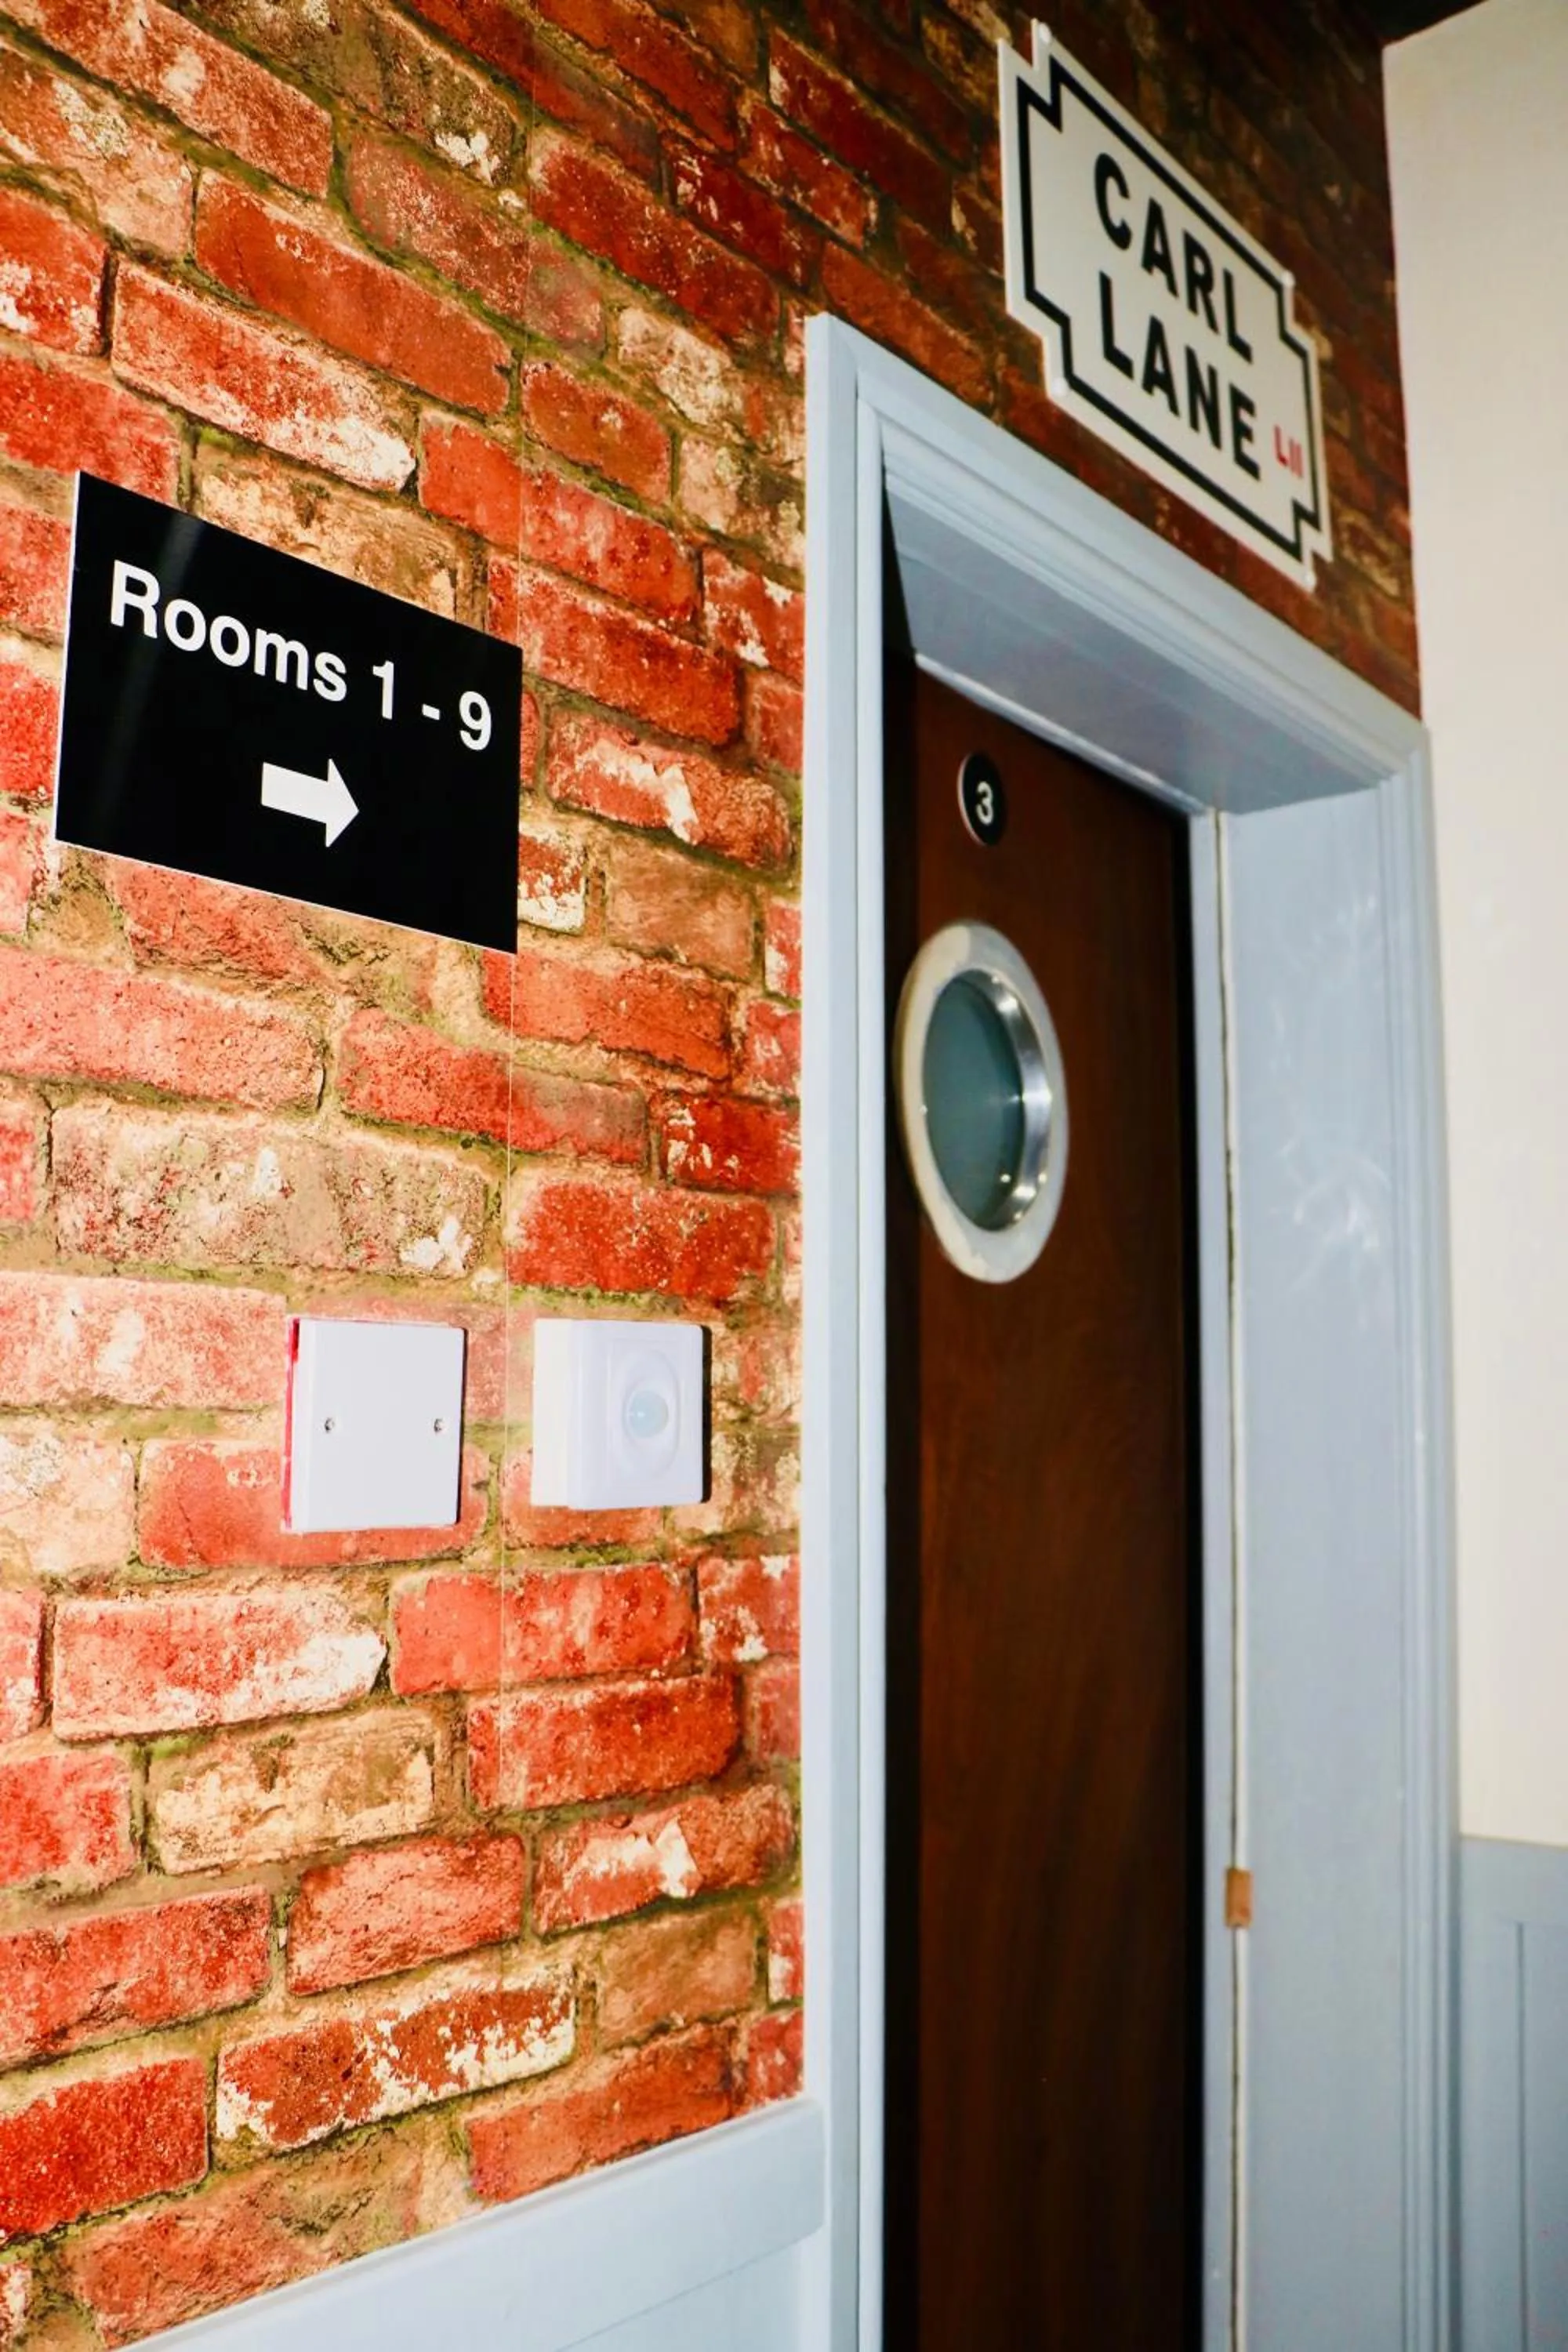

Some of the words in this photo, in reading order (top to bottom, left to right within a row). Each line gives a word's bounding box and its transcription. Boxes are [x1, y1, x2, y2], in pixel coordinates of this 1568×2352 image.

[1094, 153, 1252, 365] CARL
[1099, 271, 1261, 481] LANE
[111, 560, 347, 702] Rooms
[372, 661, 394, 720] 1
[422, 704, 441, 720] -
[459, 691, 492, 750] 9
[976, 781, 994, 826] 3
